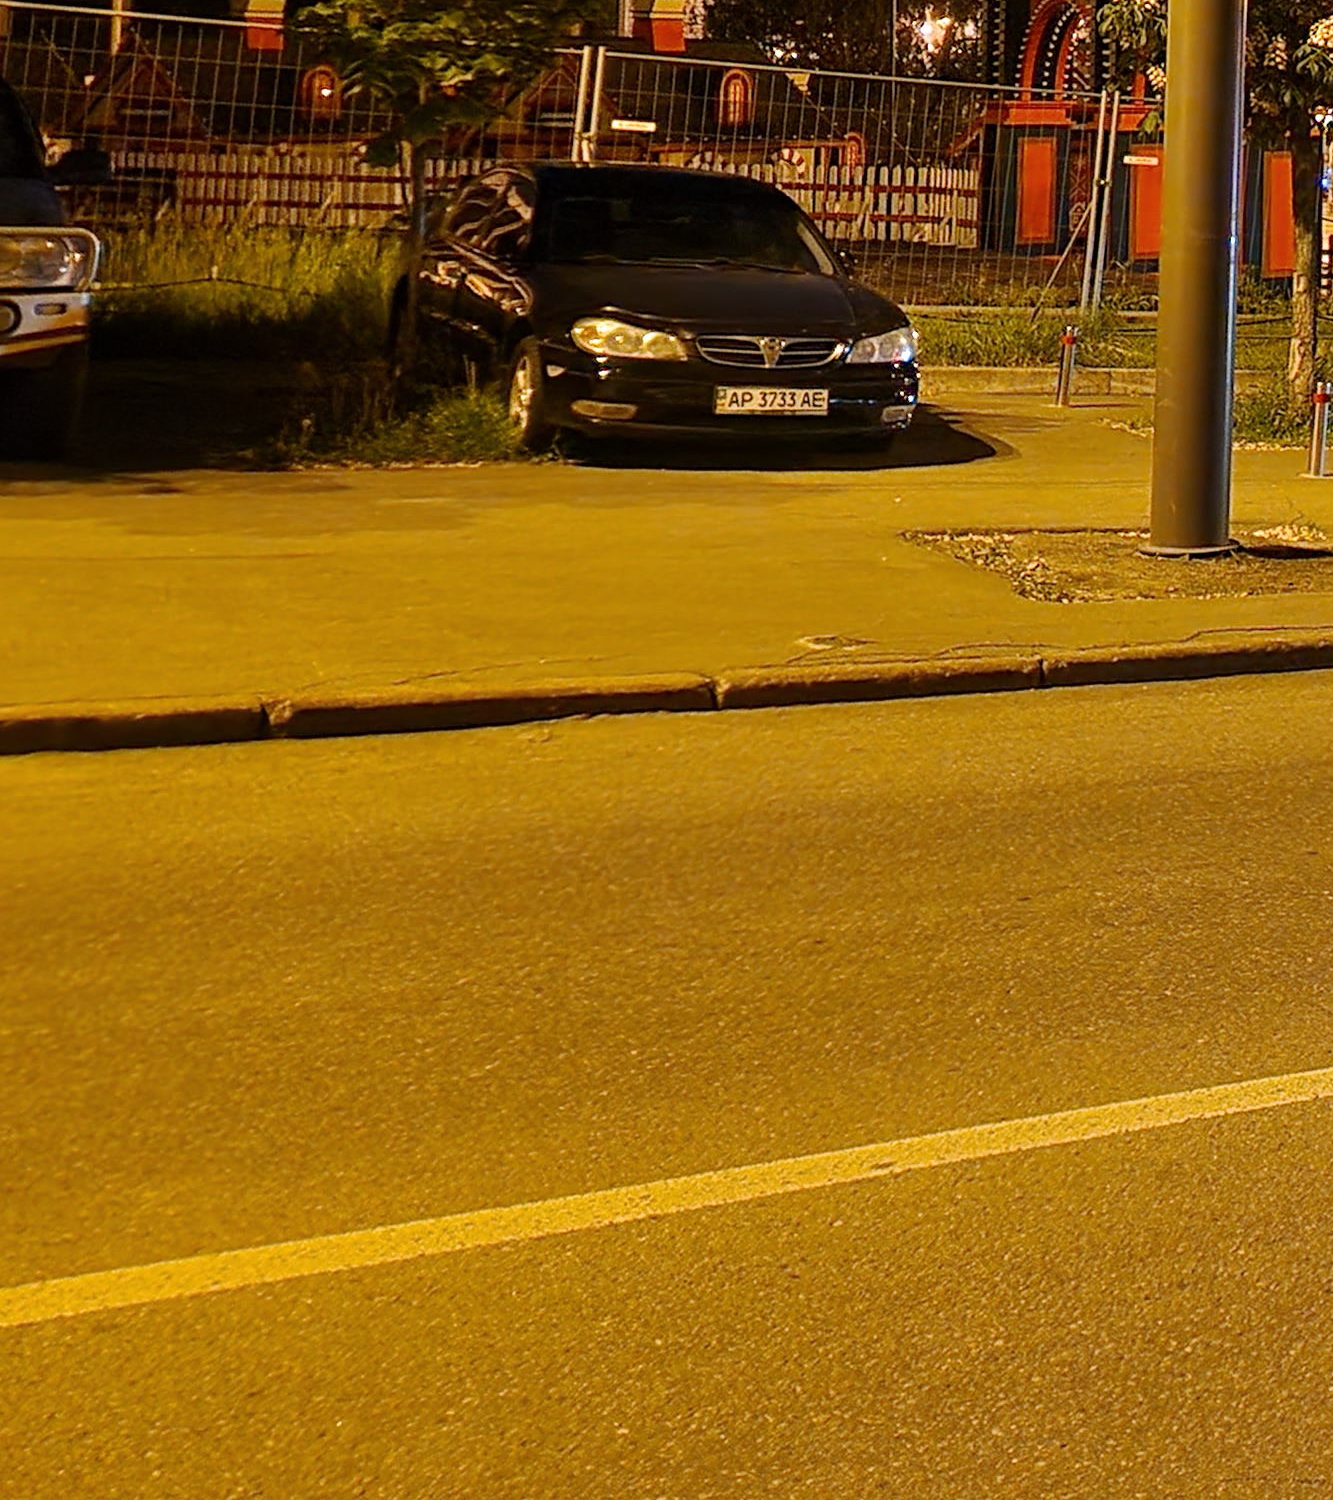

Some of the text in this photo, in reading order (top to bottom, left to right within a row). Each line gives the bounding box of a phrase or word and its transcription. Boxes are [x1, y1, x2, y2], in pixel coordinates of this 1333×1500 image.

[728, 391, 823, 407] AP 3733 AE
